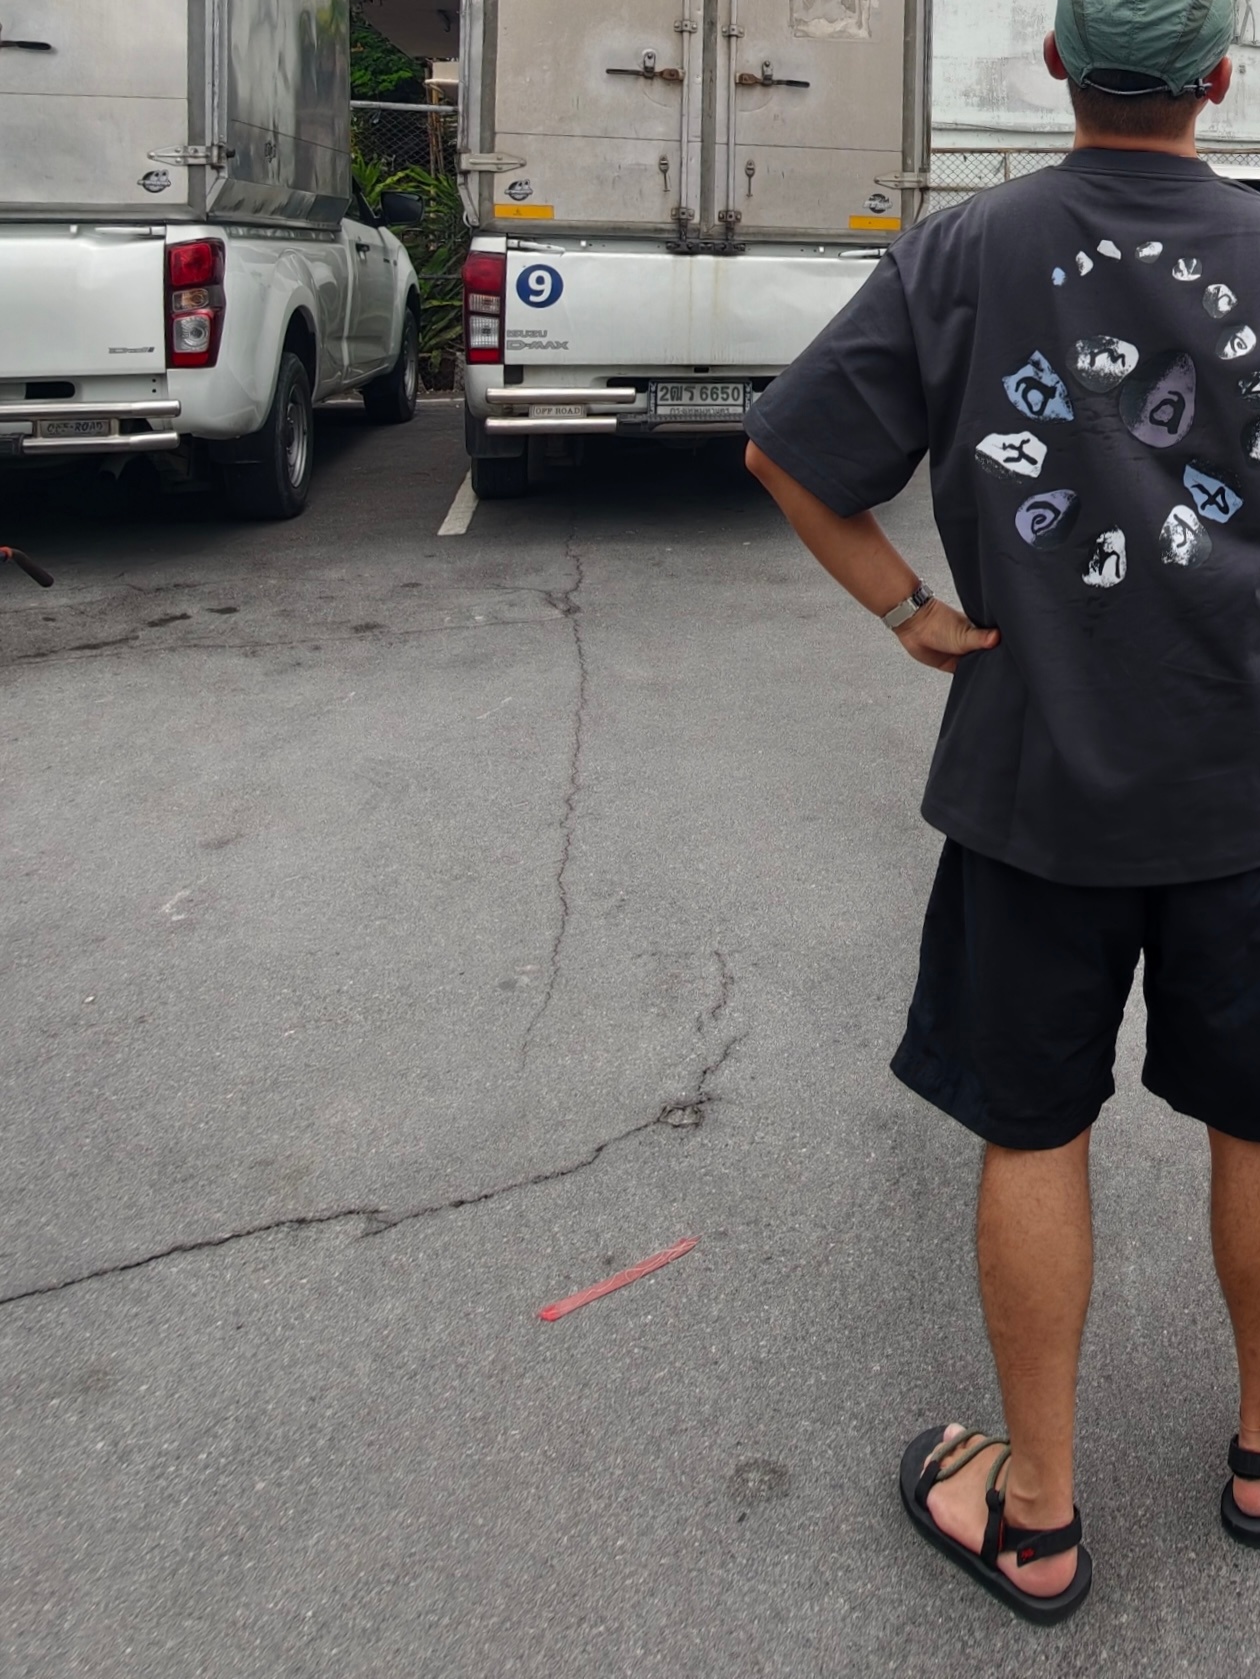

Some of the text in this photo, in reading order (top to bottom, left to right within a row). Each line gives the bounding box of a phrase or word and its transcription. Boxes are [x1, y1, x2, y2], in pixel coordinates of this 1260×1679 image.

[528, 269, 553, 302] 9
[506, 329, 548, 338] ISUZU
[506, 339, 569, 350] D-MAX
[699, 385, 741, 402] 6650
[535, 407, 580, 415] OFF ROAD
